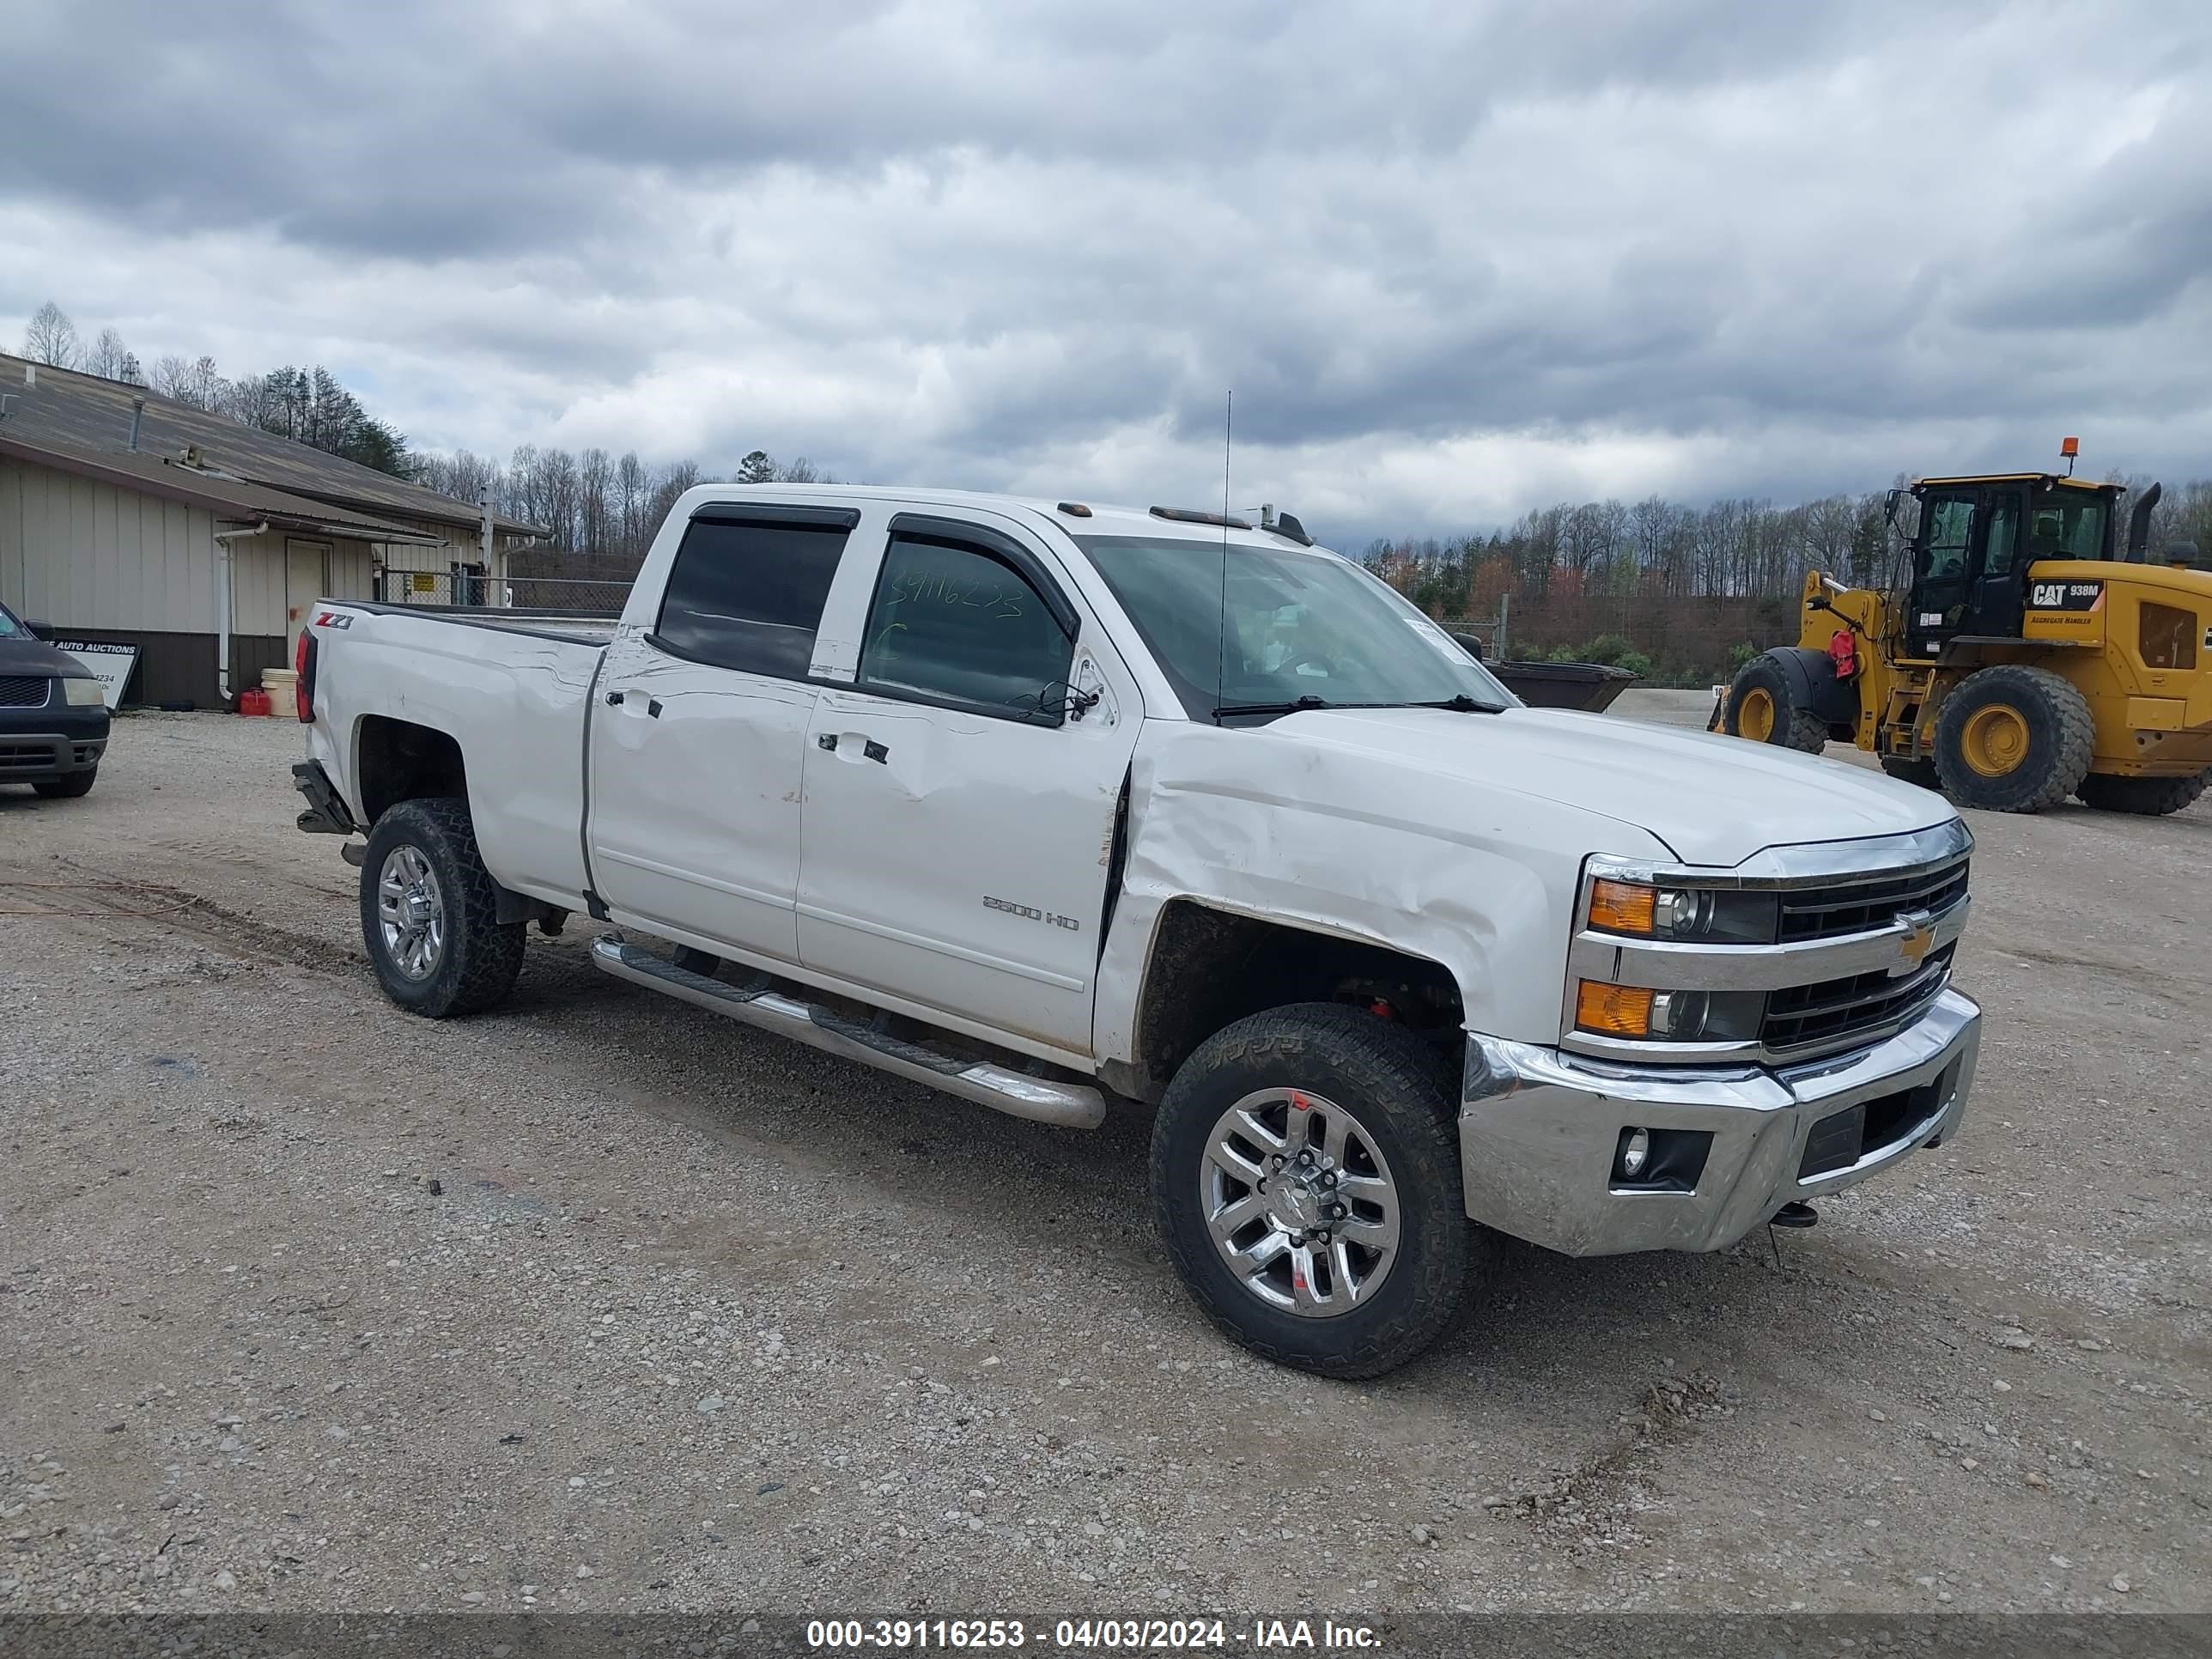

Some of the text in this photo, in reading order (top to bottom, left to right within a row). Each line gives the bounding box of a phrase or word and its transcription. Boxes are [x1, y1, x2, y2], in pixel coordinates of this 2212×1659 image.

[2033, 584, 2099, 605] CAT 938M
[314, 611, 355, 630] Z71
[57, 641, 83, 650] AUTO
[85, 644, 136, 653] AUCTIONS
[982, 896, 1079, 931] 2500 HD
